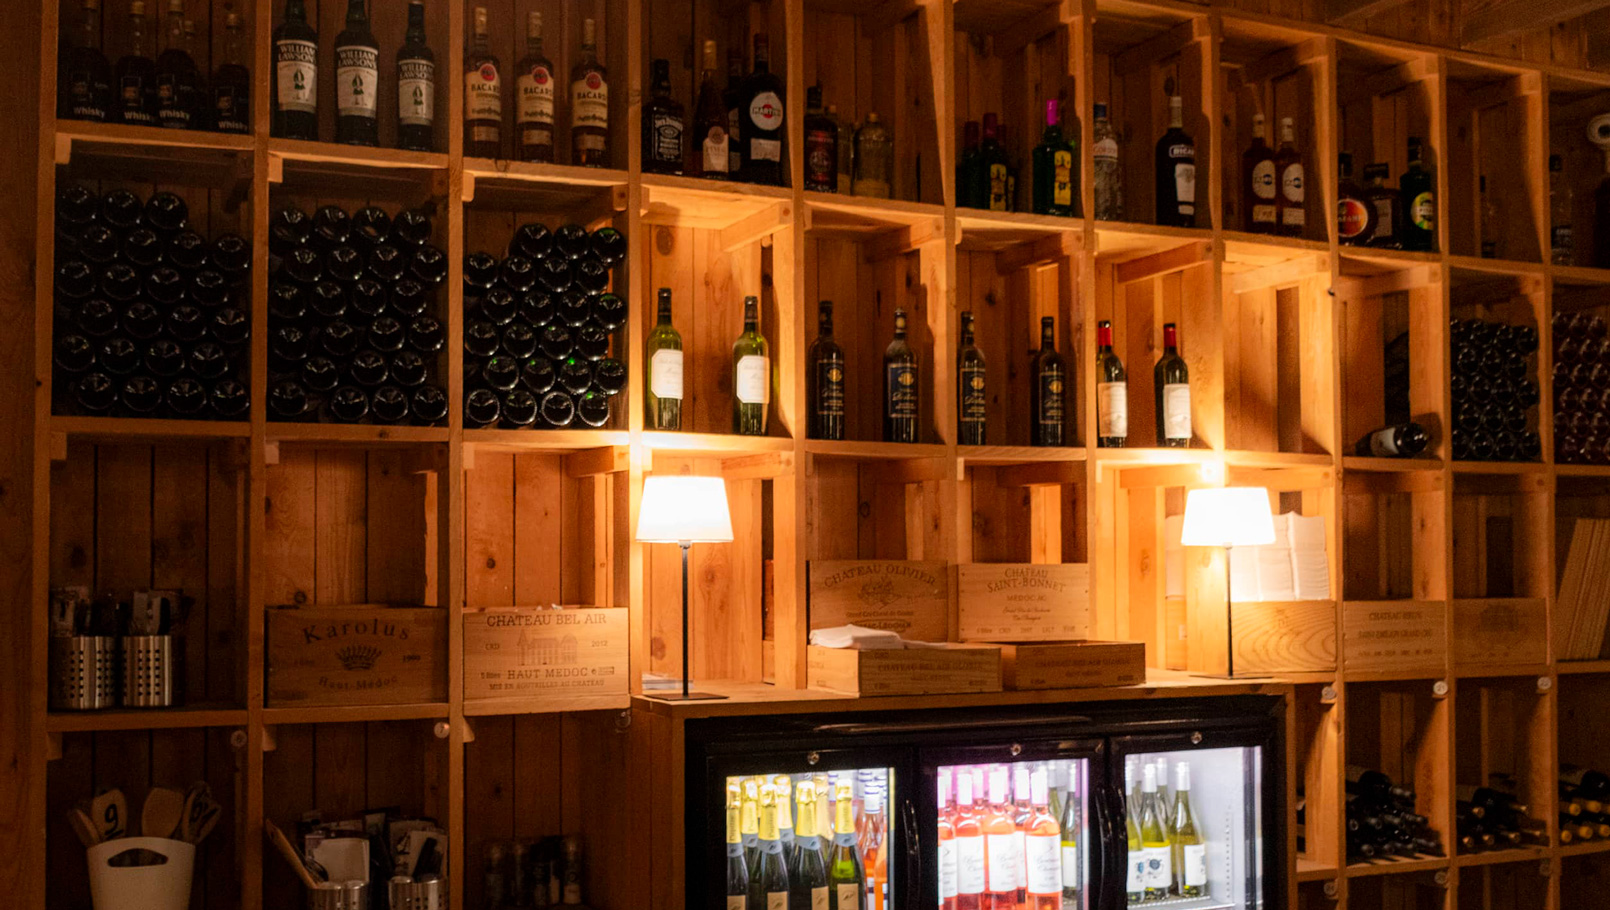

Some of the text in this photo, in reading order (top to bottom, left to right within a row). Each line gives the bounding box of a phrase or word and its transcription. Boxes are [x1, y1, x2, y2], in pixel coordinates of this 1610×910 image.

[279, 44, 316, 57] WILLIAM
[339, 51, 376, 62] WILLIAM
[400, 64, 434, 74] WILLIAM
[74, 106, 106, 119] Whisky
[158, 109, 191, 121] Whisky
[824, 564, 936, 588] CHATEAU OLIVIER
[986, 578, 1067, 594] SAINT-BONNET
[486, 613, 607, 627] CHATEAU BEL AIR
[303, 618, 410, 645] Karolus
[507, 669, 540, 680] HAUT
[545, 667, 588, 679] MEDOC
